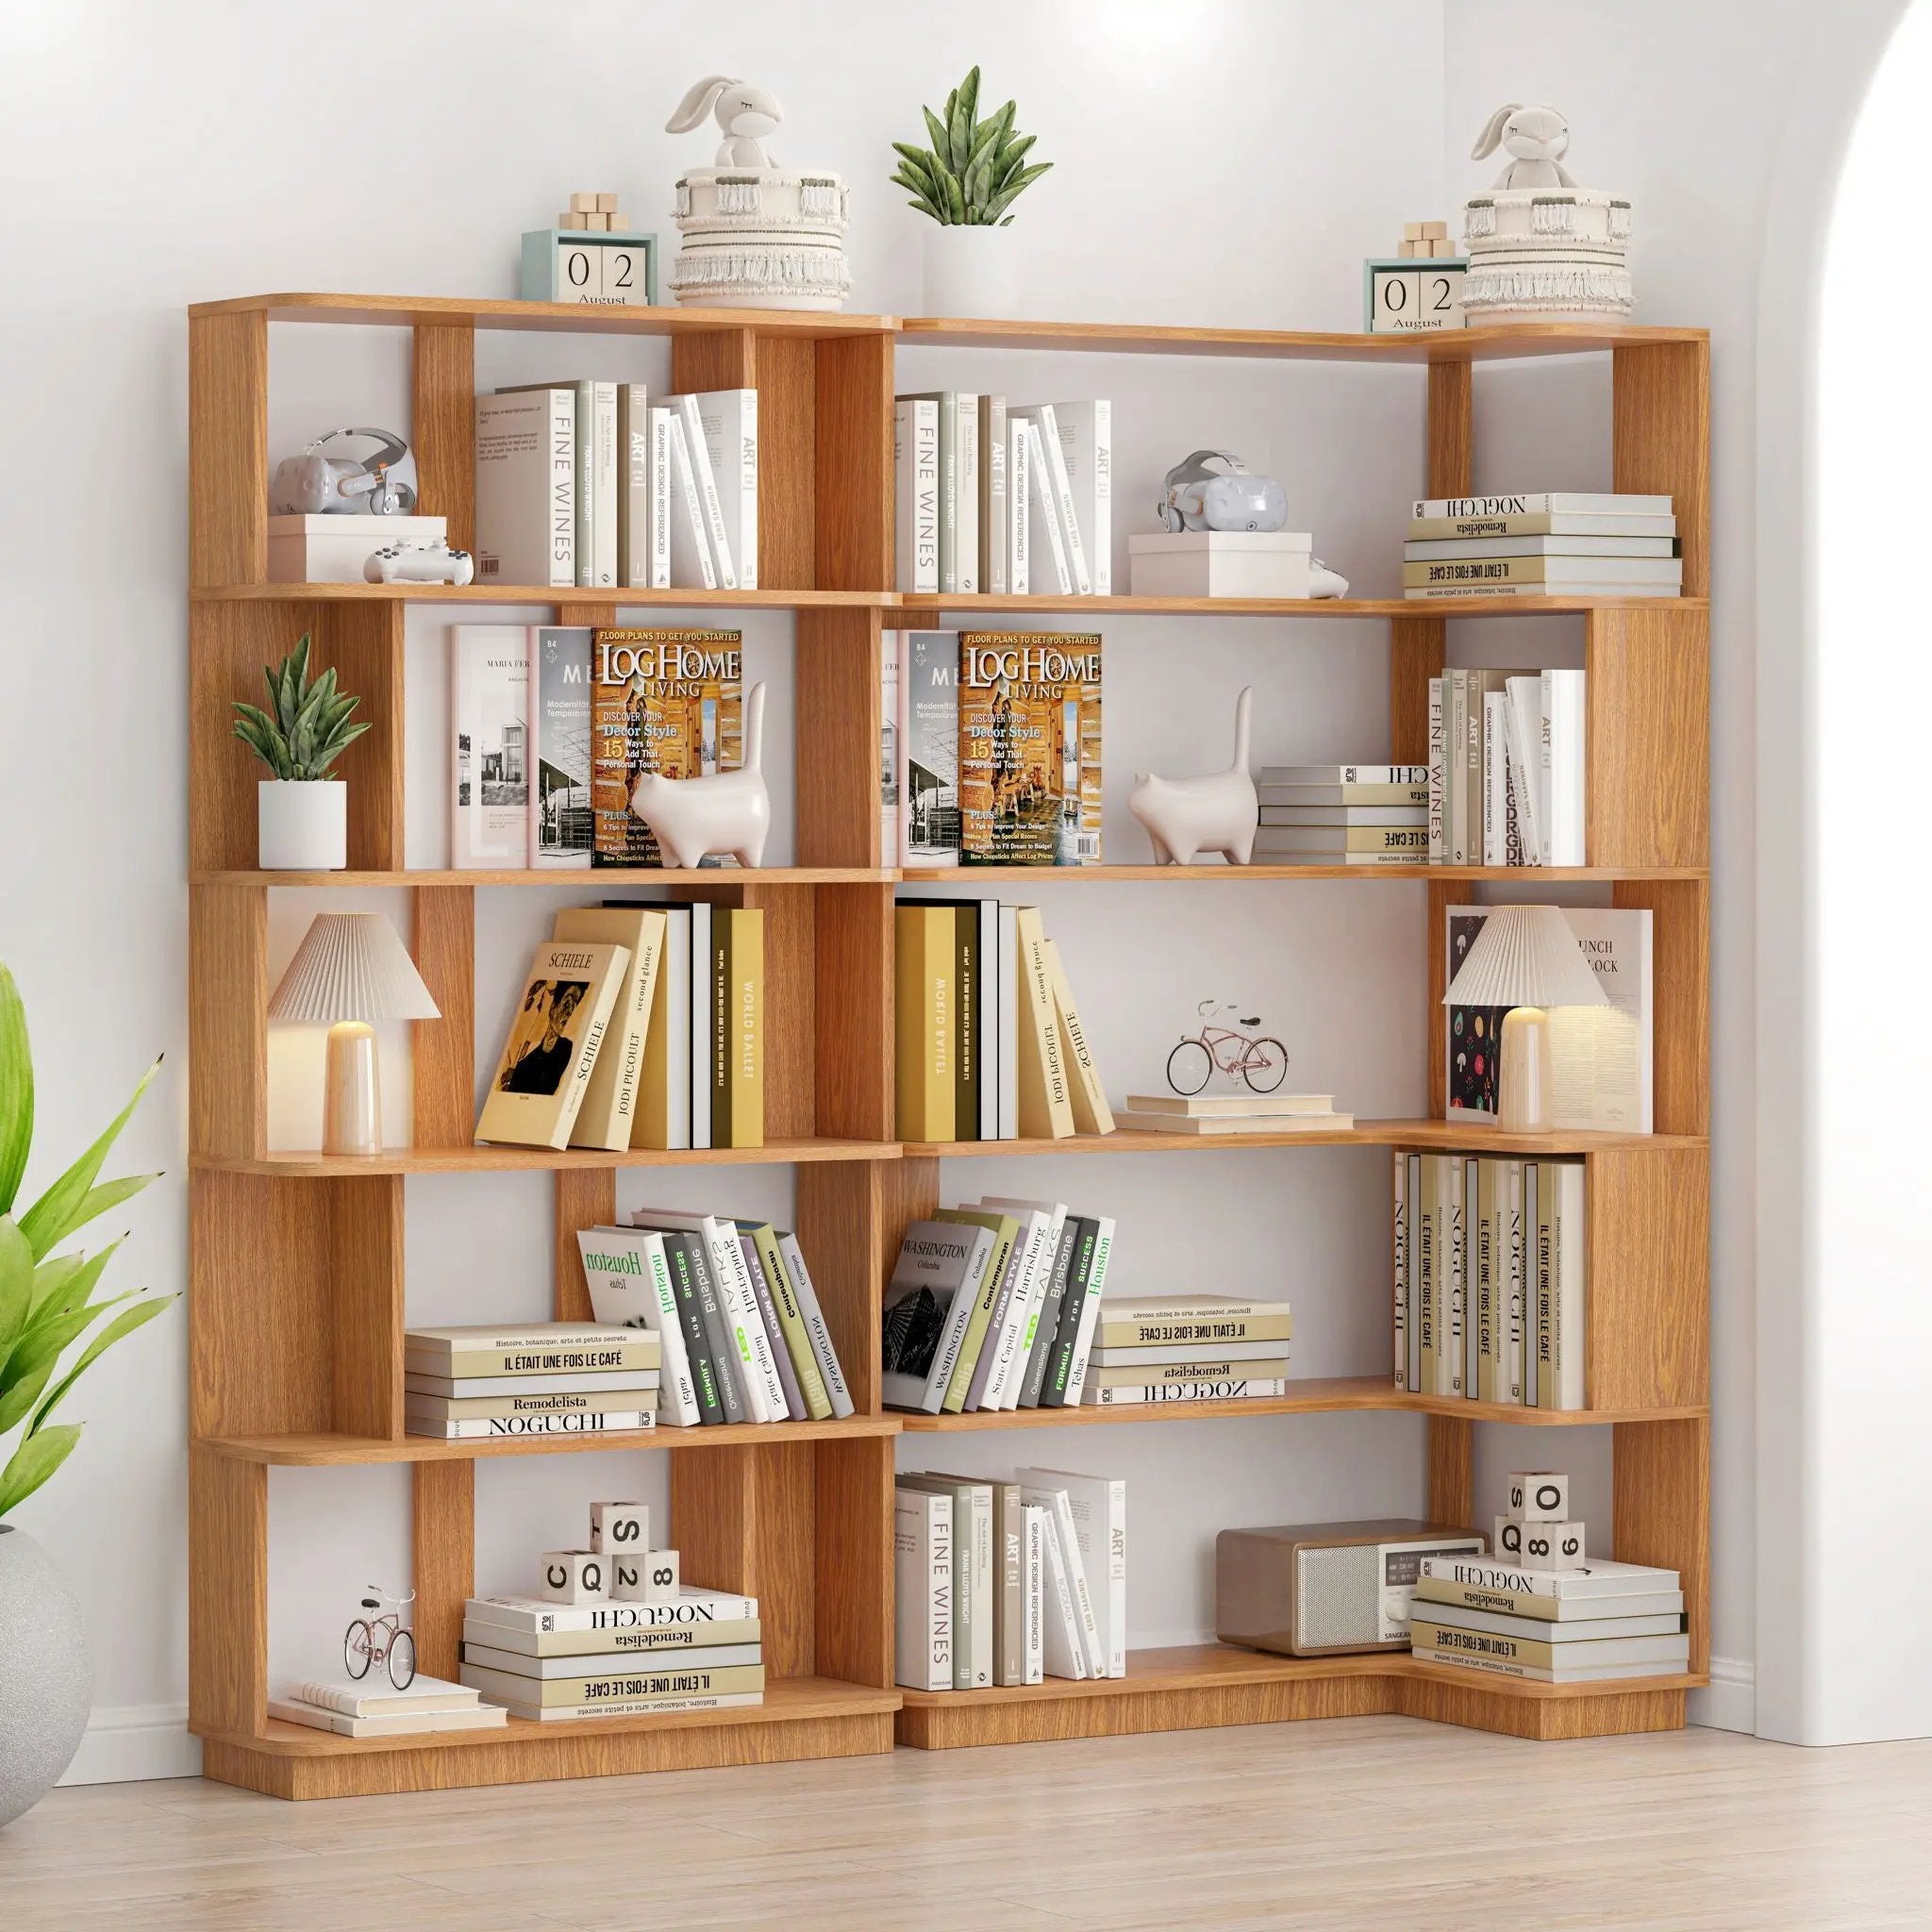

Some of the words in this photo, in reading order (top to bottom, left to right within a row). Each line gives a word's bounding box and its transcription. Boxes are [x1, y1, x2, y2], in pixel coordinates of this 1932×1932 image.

[568, 252, 590, 287] 0
[614, 254, 635, 289] 2
[579, 293, 626, 306] August
[1384, 279, 1407, 311] 0
[1432, 278, 1453, 311] 2
[1393, 318, 1443, 330] August
[555, 417, 571, 470] FINE
[631, 432, 645, 464] ART
[742, 437, 756, 468] ART
[920, 427, 934, 478] FINE
[992, 441, 1005, 474] ART
[1097, 446, 1109, 477] ART
[1447, 496, 1525, 517] NOGUCHI
[555, 482, 571, 561] WINES
[920, 491, 934, 567] WINES
[1457, 523, 1507, 535] Remodelista
[600, 631, 625, 641] FLOOR
[628, 632, 654, 641] PLANS
[705, 633, 739, 641] STARTED
[967, 635, 991, 643] FLOOR
[1066, 636, 1099, 644] STARTED
[641, 682, 700, 697] LIVING
[1007, 684, 1062, 698] LIVING
[604, 711, 640, 722] DISCOVER
[642, 711, 662, 722] YOUR
[971, 714, 1006, 723] DISCOVER
[1008, 713, 1026, 723] YOUR
[1431, 704, 1441, 754] FINE
[604, 724, 641, 737] Decor
[644, 724, 677, 740] Style
[970, 726, 1007, 738] Decor
[1009, 725, 1040, 741] Style
[1469, 716, 1477, 746] ART
[1542, 716, 1551, 747] ART
[604, 740, 623, 758] 15
[625, 740, 643, 748] Ways
[970, 741, 990, 758] 15
[991, 741, 1008, 749] Ways
[1431, 765, 1441, 840] WINES
[549, 953, 593, 969] SCHIELE
[641, 945, 653, 976] glance
[638, 979, 647, 1011] second
[743, 981, 754, 1028] WORLD
[577, 1021, 605, 1081] SCHIELE
[624, 1032, 640, 1085] PICOULT
[743, 1034, 754, 1078] BALLET
[619, 1088, 631, 1115] JODI
[1423, 1215, 1430, 1224] IL
[904, 1240, 968, 1258] WASHINGTON
[1423, 1227, 1431, 1255] ÉTAIT
[983, 1241, 1009, 1309] Contemporan
[1015, 1226, 1046, 1303] Harrisburg
[1034, 1228, 1061, 1303] TALKS
[1090, 1238, 1110, 1295] Houston
[1423, 1258, 1431, 1276] UNE
[993, 1294, 1009, 1328] FORM
[1006, 1247, 1022, 1289] STYLE
[1423, 1279, 1431, 1306] FOIS
[936, 1310, 967, 1390] WASHINGTON
[973, 1247, 987, 1279] Columbia
[1031, 1342, 1048, 1394] Queensland
[1050, 1235, 1074, 1298] Brisbane
[1056, 1342, 1072, 1391] FORMULA
[1071, 1300, 1080, 1322] FOR
[1078, 1236, 1093, 1282] SUCCESS
[1423, 1307, 1431, 1320] LE
[583, 1336, 602, 1344] petits
[1423, 1324, 1431, 1349] CAFÉ
[505, 1357, 513, 1370] IL
[515, 1355, 541, 1369] ÉTAIT
[543, 1355, 560, 1368] UNE
[563, 1354, 583, 1367] FOIS
[586, 1353, 596, 1366] LE
[599, 1350, 622, 1365] CAFÉ
[992, 1366, 1005, 1393] State
[1001, 1324, 1018, 1363] Capital
[513, 1396, 587, 1409] Remodelista
[490, 1413, 604, 1435] NOGUCHI
[1511, 1487, 1522, 1507] S
[613, 1521, 640, 1541] S
[1111, 1528, 1124, 1558] ART
[1502, 1524, 1521, 1554] Q
[934, 1524, 948, 1575] FINE
[1007, 1533, 1019, 1564] ART
[1528, 1539, 1549, 1557] 8
[547, 1565, 566, 1589] C
[582, 1563, 602, 1591] Q
[619, 1567, 638, 1587] 2
[653, 1568, 673, 1586] 8
[1455, 1565, 1533, 1593] NOGUCHI
[1464, 1591, 1514, 1611] Remodelista
[591, 1604, 714, 1629] NOGUCHI
[934, 1586, 948, 1664] WINES
[615, 1632, 693, 1647] Remodelista
[585, 1682, 609, 1700] CAFÉ
[612, 1681, 624, 1695] LE
[626, 1679, 647, 1694] FOIS
[650, 1677, 669, 1692] UNE
[672, 1675, 698, 1692] ÉTAIT
[702, 1675, 709, 1689] IL
